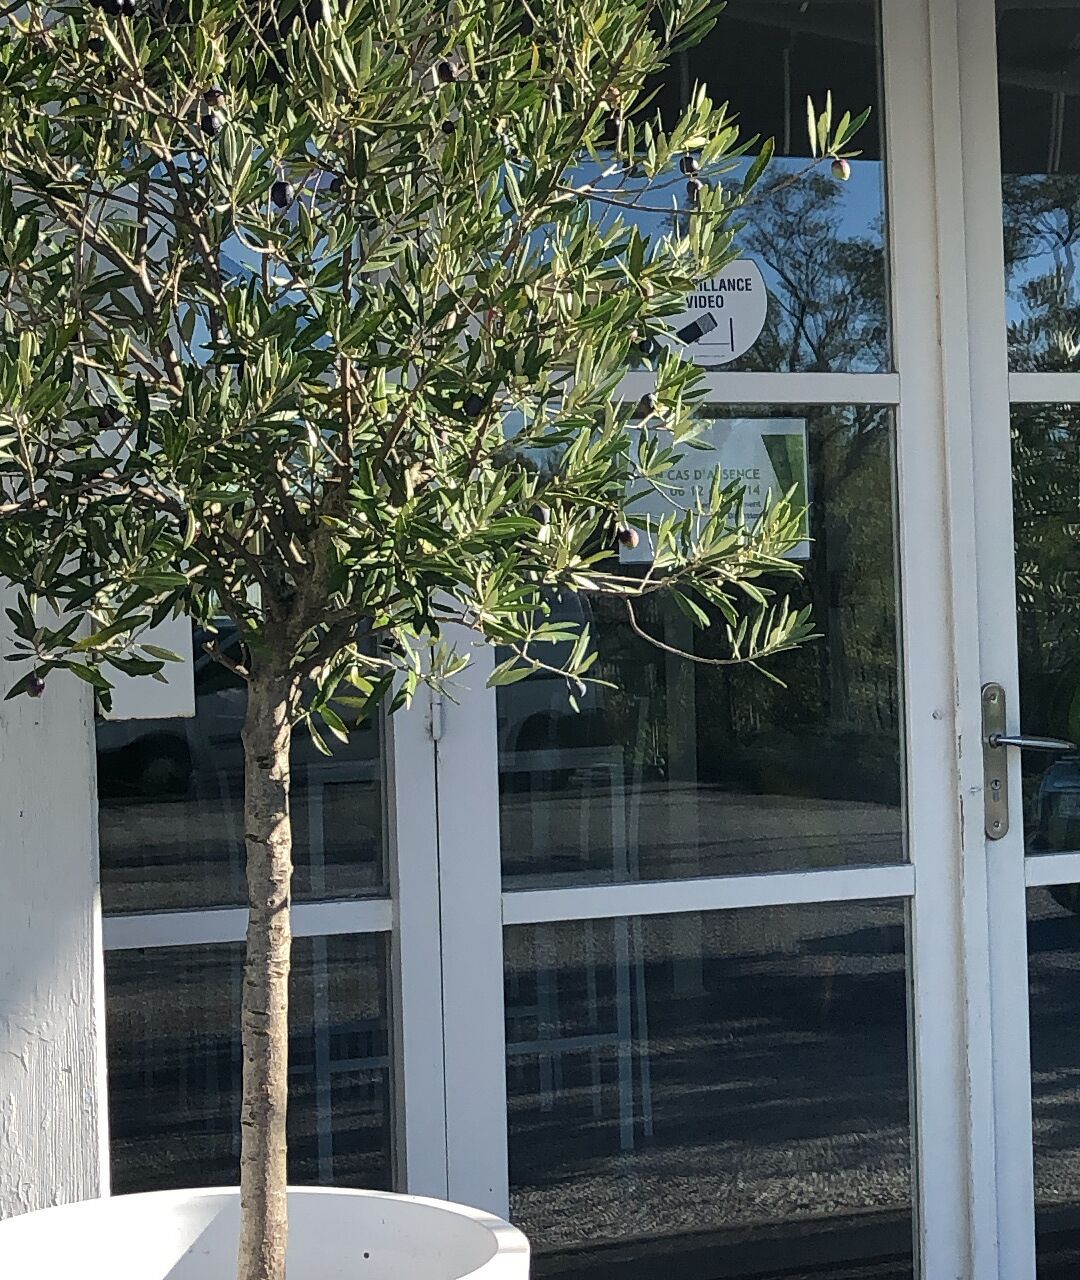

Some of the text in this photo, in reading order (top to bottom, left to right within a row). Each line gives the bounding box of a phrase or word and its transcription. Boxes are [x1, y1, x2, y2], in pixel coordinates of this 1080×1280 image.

[686, 295, 724, 309] VIDEO
[667, 469, 690, 481] CAS
[694, 468, 760, 480] D'ASENCE
